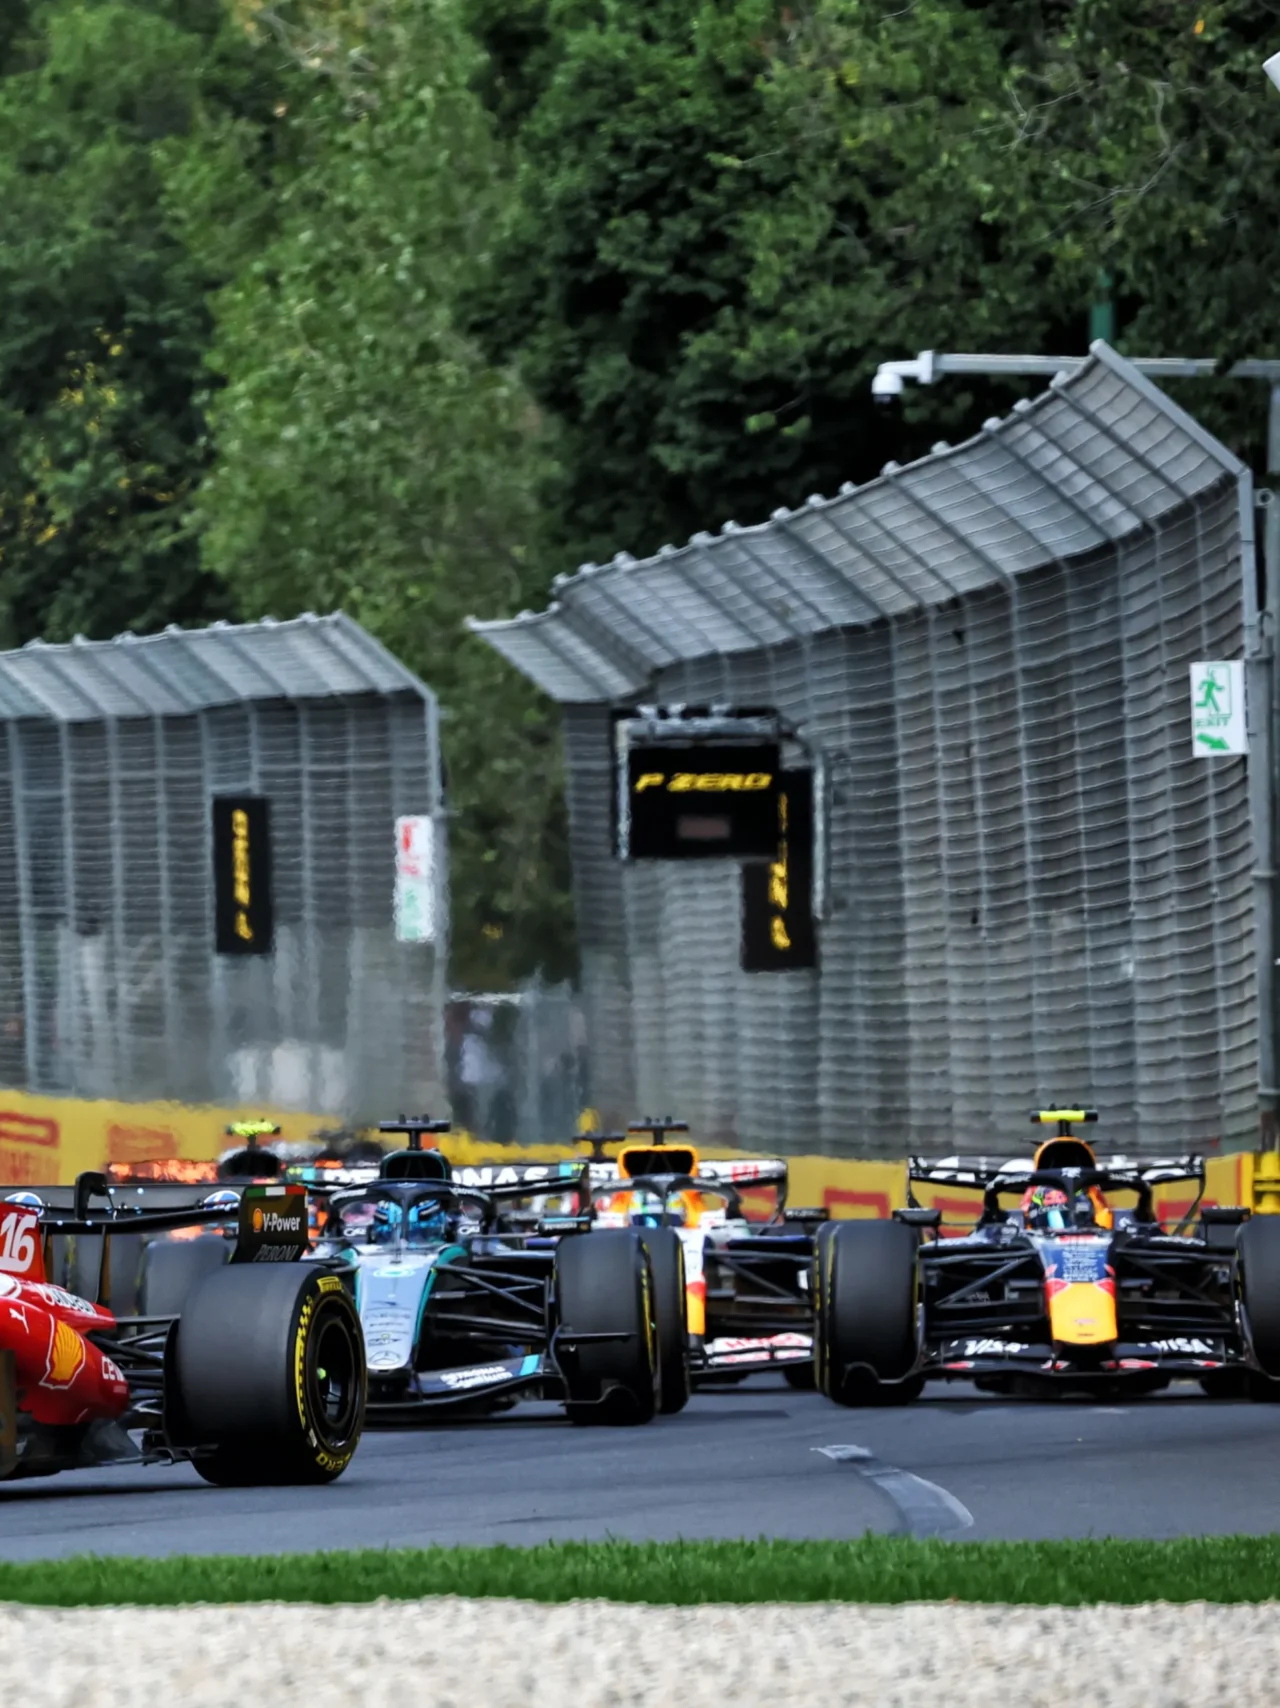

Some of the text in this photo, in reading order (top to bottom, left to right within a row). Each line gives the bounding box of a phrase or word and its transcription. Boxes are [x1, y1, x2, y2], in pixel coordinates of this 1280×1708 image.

[1194, 714, 1230, 728] EXIT
[634, 772, 773, 792] P ZERO
[262, 1212, 301, 1232] V-Power
[253, 1244, 299, 1262] PERONI
[1151, 1338, 1213, 1354] VISA
